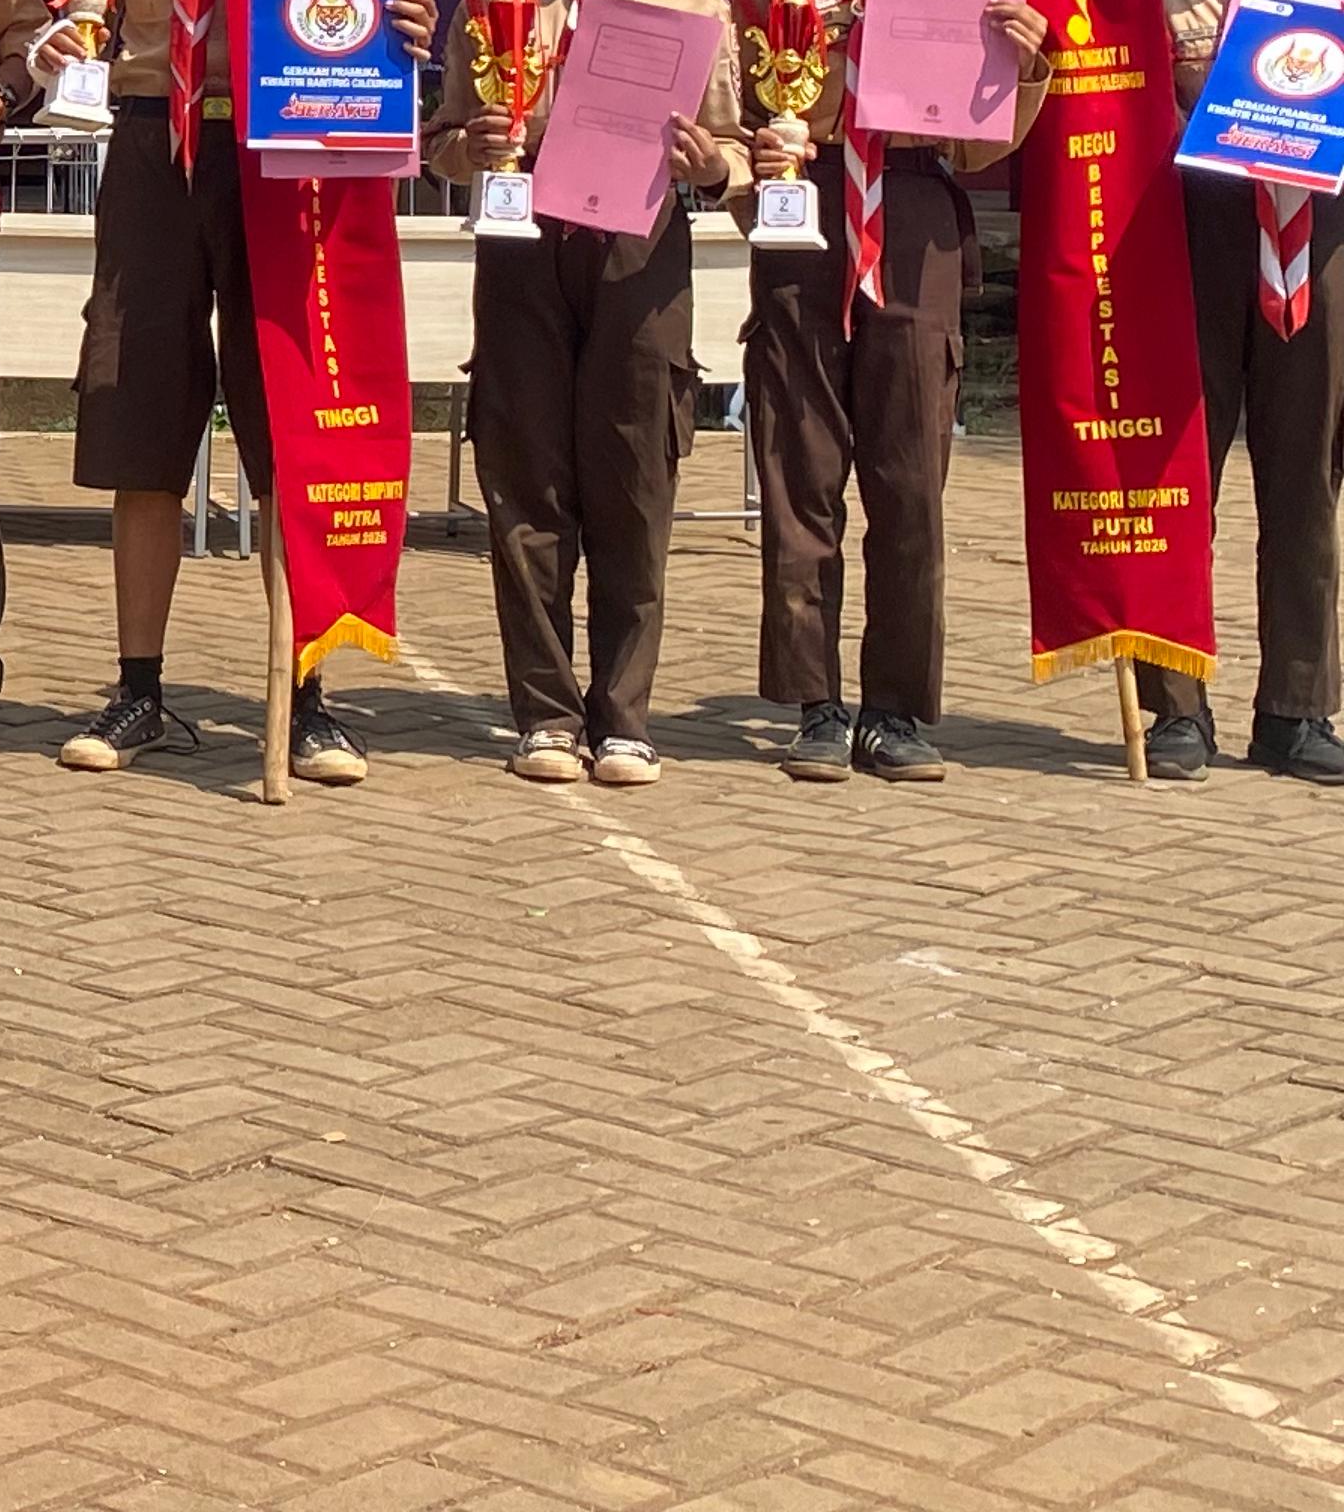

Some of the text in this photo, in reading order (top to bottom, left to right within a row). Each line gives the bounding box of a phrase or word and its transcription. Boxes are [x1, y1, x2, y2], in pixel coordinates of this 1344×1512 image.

[1119, 45, 1130, 65] II
[282, 66, 329, 76] GERAKAN
[1068, 130, 1116, 159] REGU
[503, 188, 512, 206] 3
[779, 195, 789, 213] 2
[1088, 163, 1120, 410] BERPRESTASI
[314, 404, 380, 430] TINGGI
[1073, 416, 1163, 441] TINGGI
[306, 482, 362, 503] KATEGORI
[1052, 489, 1125, 510] KATEGORI
[333, 508, 382, 529] PUTRA
[1092, 515, 1154, 536] PUTRI
[326, 532, 361, 547] TAHUN
[1080, 538, 1168, 555] TAHUN 2026
